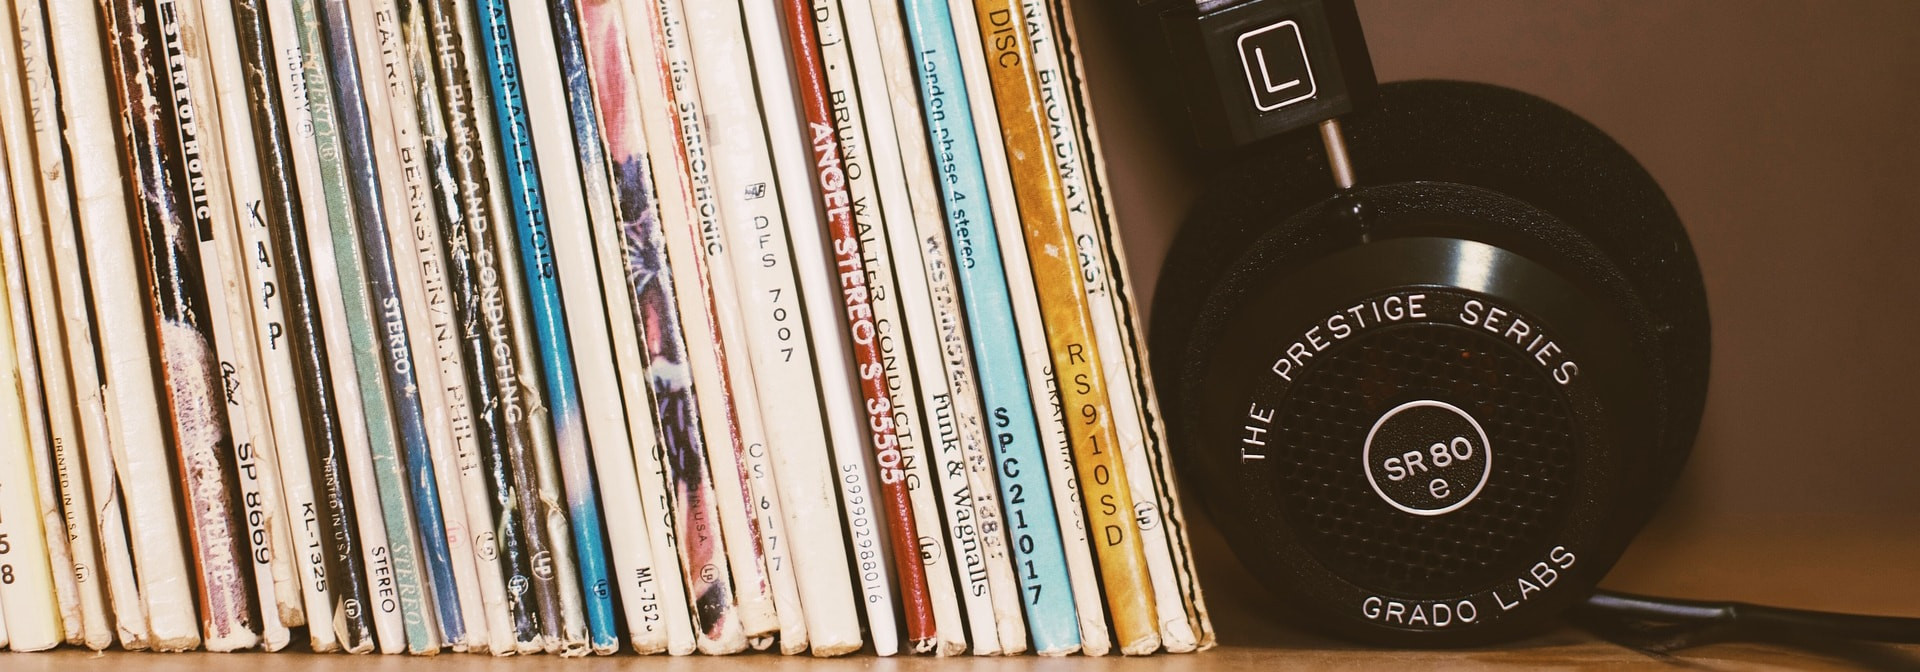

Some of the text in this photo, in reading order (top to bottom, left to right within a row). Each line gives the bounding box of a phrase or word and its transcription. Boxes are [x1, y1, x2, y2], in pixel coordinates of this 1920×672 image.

[989, 8, 1020, 69] DISC
[1254, 46, 1300, 93] L
[164, 22, 211, 221] STEREOPHONIC
[921, 49, 946, 122] London
[933, 128, 958, 184] phase
[950, 191, 966, 202] 4
[1039, 68, 1087, 215] BROADWAY
[1077, 233, 1105, 297] CAST
[435, 16, 458, 70] THE
[448, 83, 475, 164] PIANO
[462, 181, 488, 235] AND
[475, 249, 523, 424] CONDUCTING
[523, 186, 554, 281] CHOIR
[754, 215, 777, 268] DFS
[769, 288, 794, 363] 7007
[811, 121, 905, 485] ANGEL STEREO S 35505
[831, 90, 862, 181] BRUNO
[854, 196, 886, 302] WALTER
[877, 318, 921, 491] CONDUCTING
[383, 296, 411, 375] STEREO
[1241, 294, 1580, 465] THE PRESTIGE SERIES
[55, 437, 69, 488] PRINTED
[63, 493, 73, 506] IN
[1067, 343, 1123, 547] RS910SD
[1429, 478, 1450, 498] e
[238, 443, 270, 566] SP 8669
[332, 514, 341, 526] IN
[760, 496, 782, 571] 6177
[843, 464, 883, 604] 5099902988016
[933, 393, 986, 598] Funk & Wagnalls
[994, 406, 1041, 606] SPC21017
[302, 502, 328, 593] KL-1325
[372, 546, 396, 614] STEREO
[392, 542, 421, 626] STEREO
[1362, 545, 1576, 627] GRADO LABS
